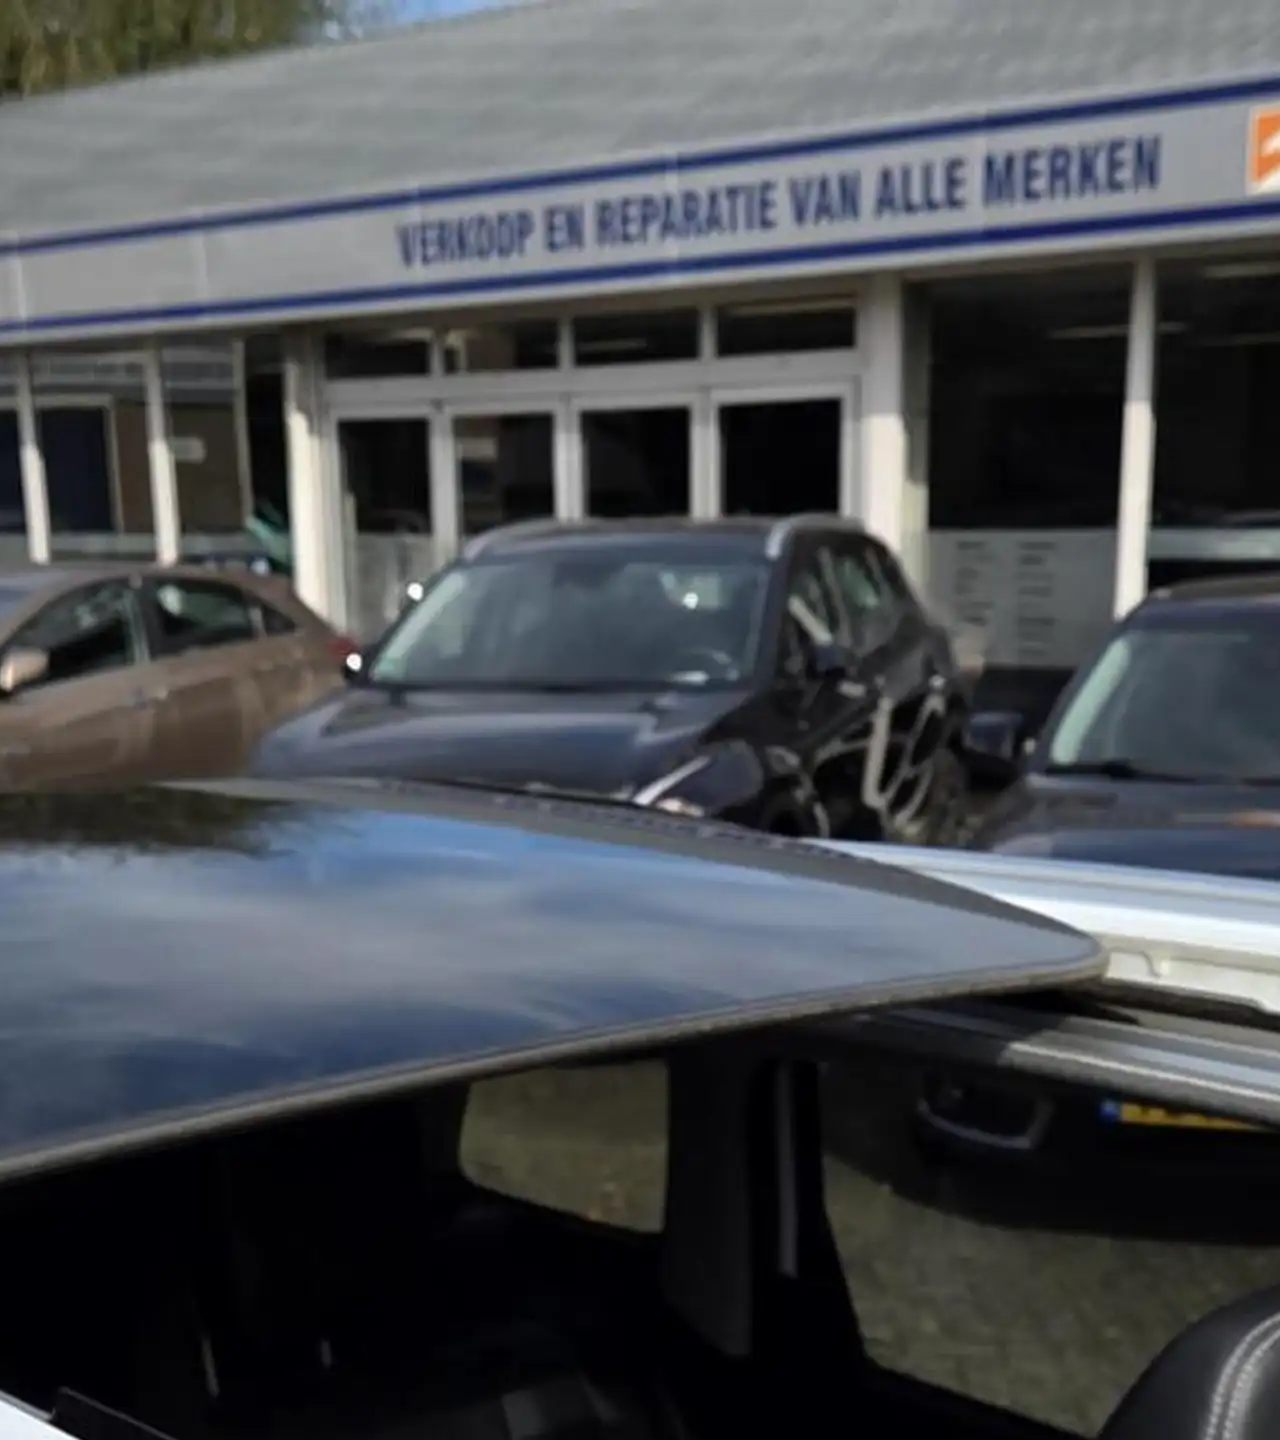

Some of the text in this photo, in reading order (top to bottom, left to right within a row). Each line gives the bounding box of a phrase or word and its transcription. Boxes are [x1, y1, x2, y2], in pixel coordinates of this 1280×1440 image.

[395, 132, 1163, 269] VERKOOP EN REPARATIE VAN ALLE MERKEN
